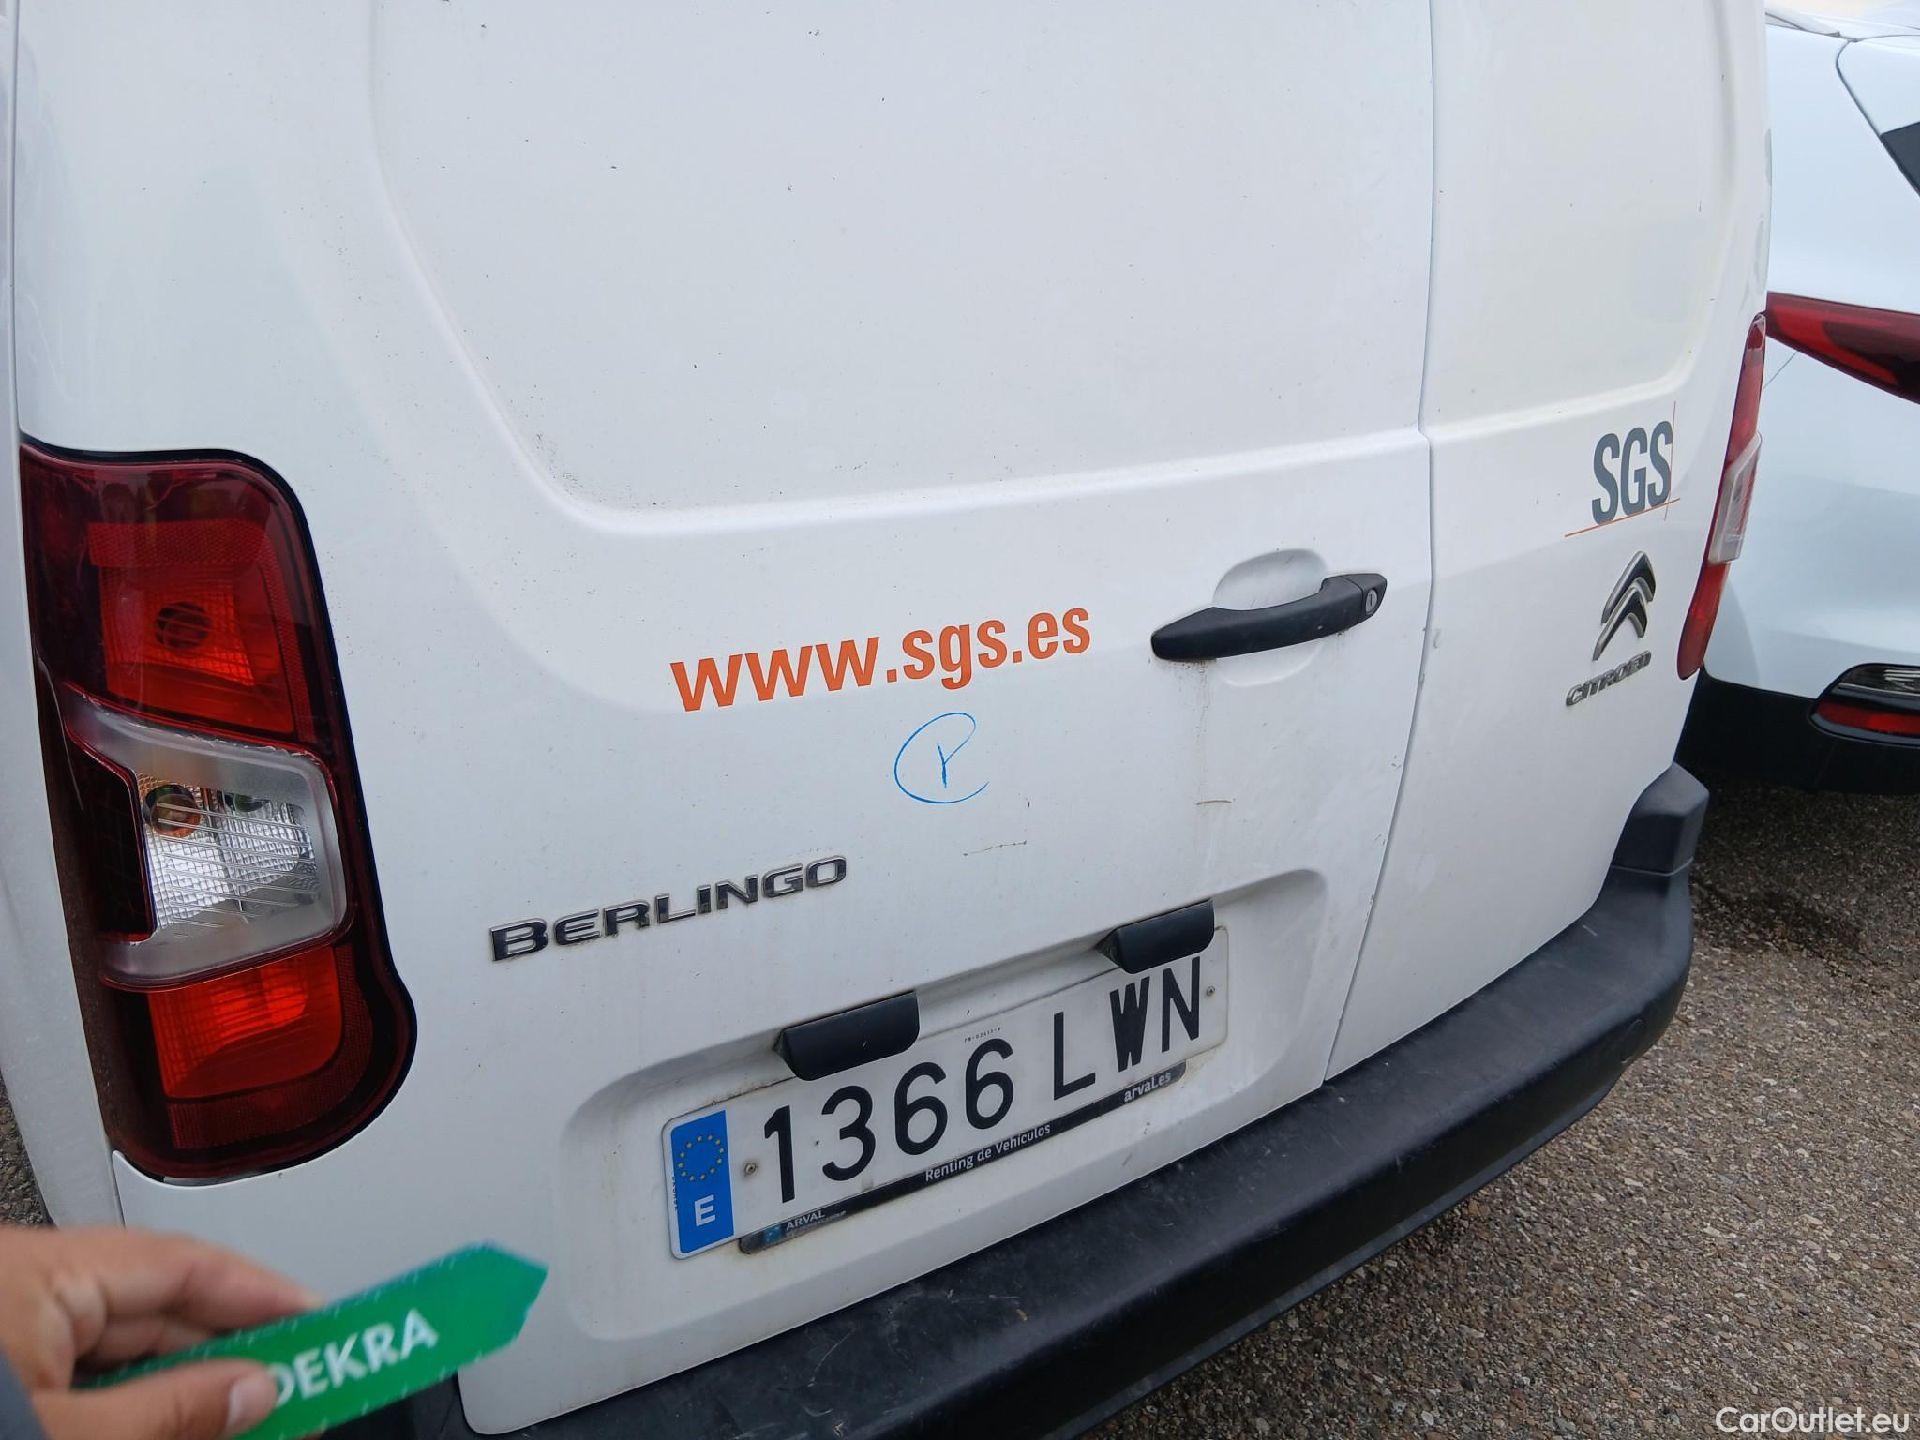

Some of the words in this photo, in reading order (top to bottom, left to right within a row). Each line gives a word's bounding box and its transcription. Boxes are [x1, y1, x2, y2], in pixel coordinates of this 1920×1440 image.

[1592, 420, 1674, 526] SGS
[669, 606, 1091, 713] www.sgs.es
[489, 854, 848, 962] BERLINGO
[764, 1038, 1014, 1204] 1366
[1052, 956, 1201, 1101] LWN
[694, 1194, 717, 1227] E
[925, 1155, 974, 1181] Renting
[977, 1148, 992, 1161] de
[786, 1209, 826, 1232] ARVAL
